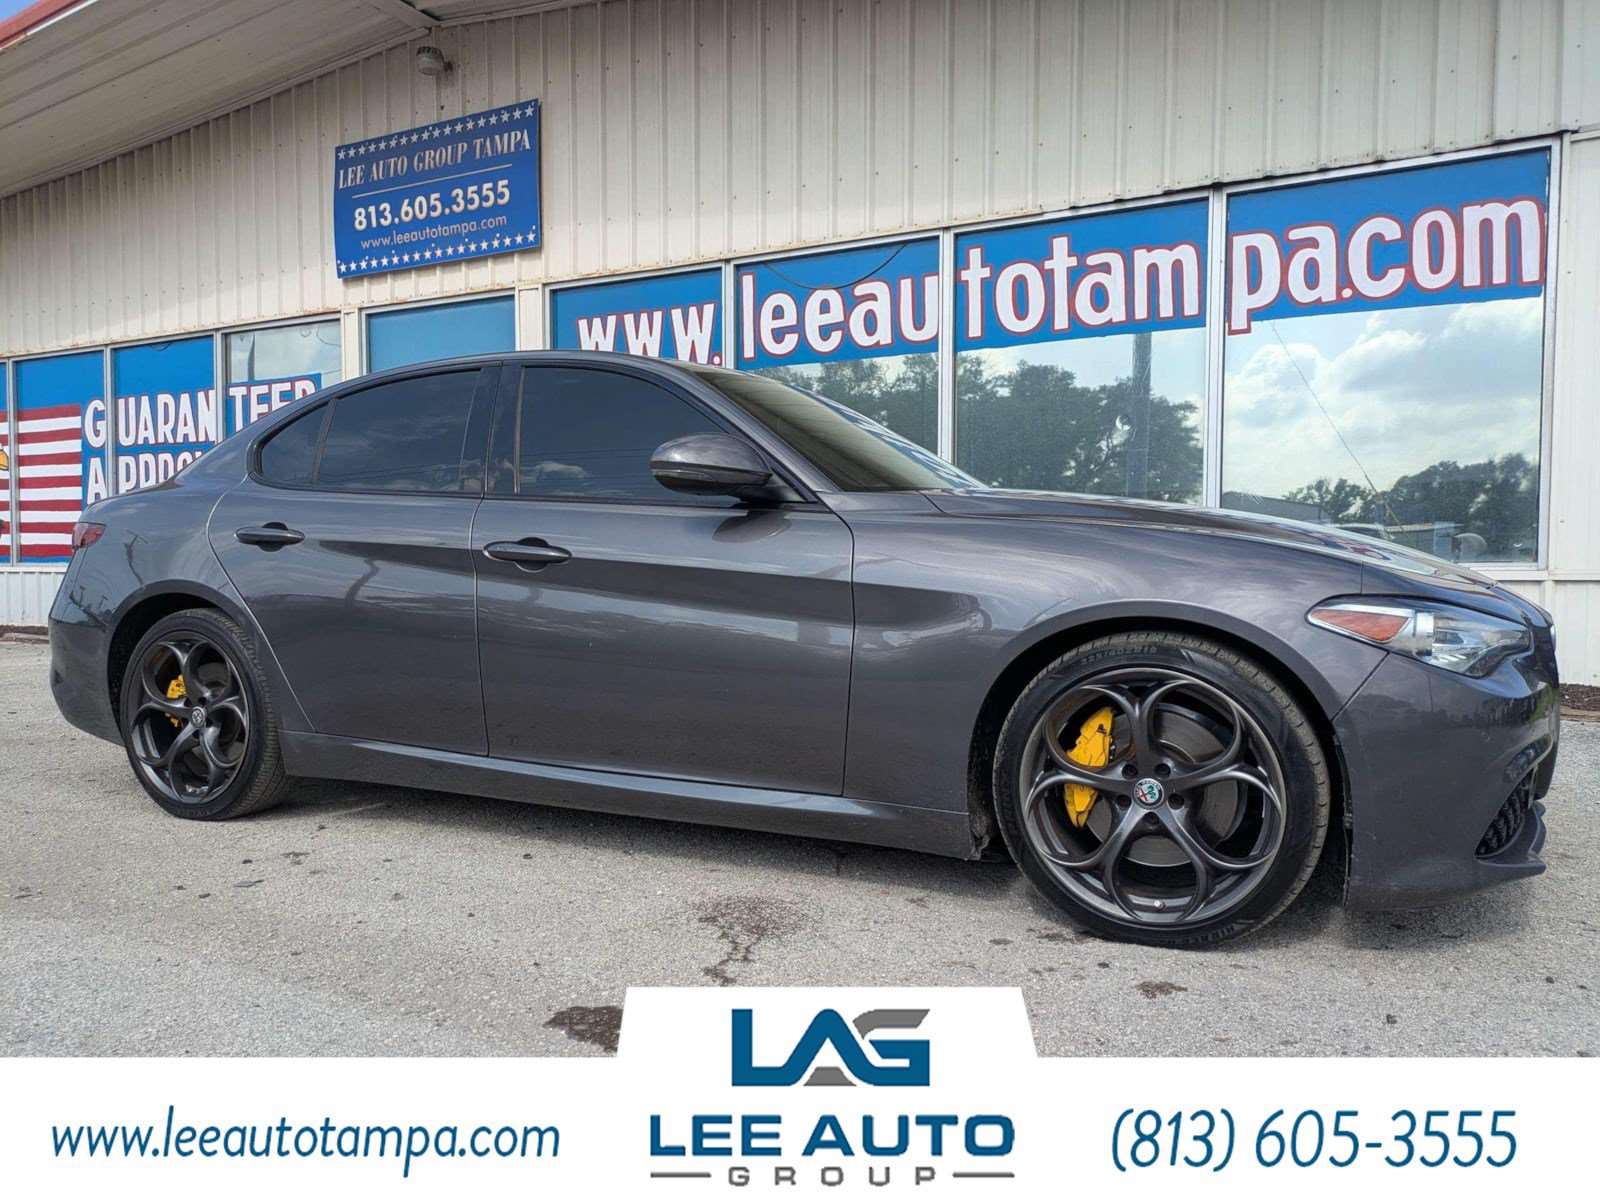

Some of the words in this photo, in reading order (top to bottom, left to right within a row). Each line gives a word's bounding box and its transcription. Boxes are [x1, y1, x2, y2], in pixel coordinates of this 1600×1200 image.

[338, 165, 365, 190] LEE
[369, 155, 408, 183] AUTO
[413, 142, 468, 173] GROUP
[473, 129, 531, 160] TAMPA
[354, 179, 511, 231] 813.605.3555
[361, 216, 507, 249] www.leeautotampa.com
